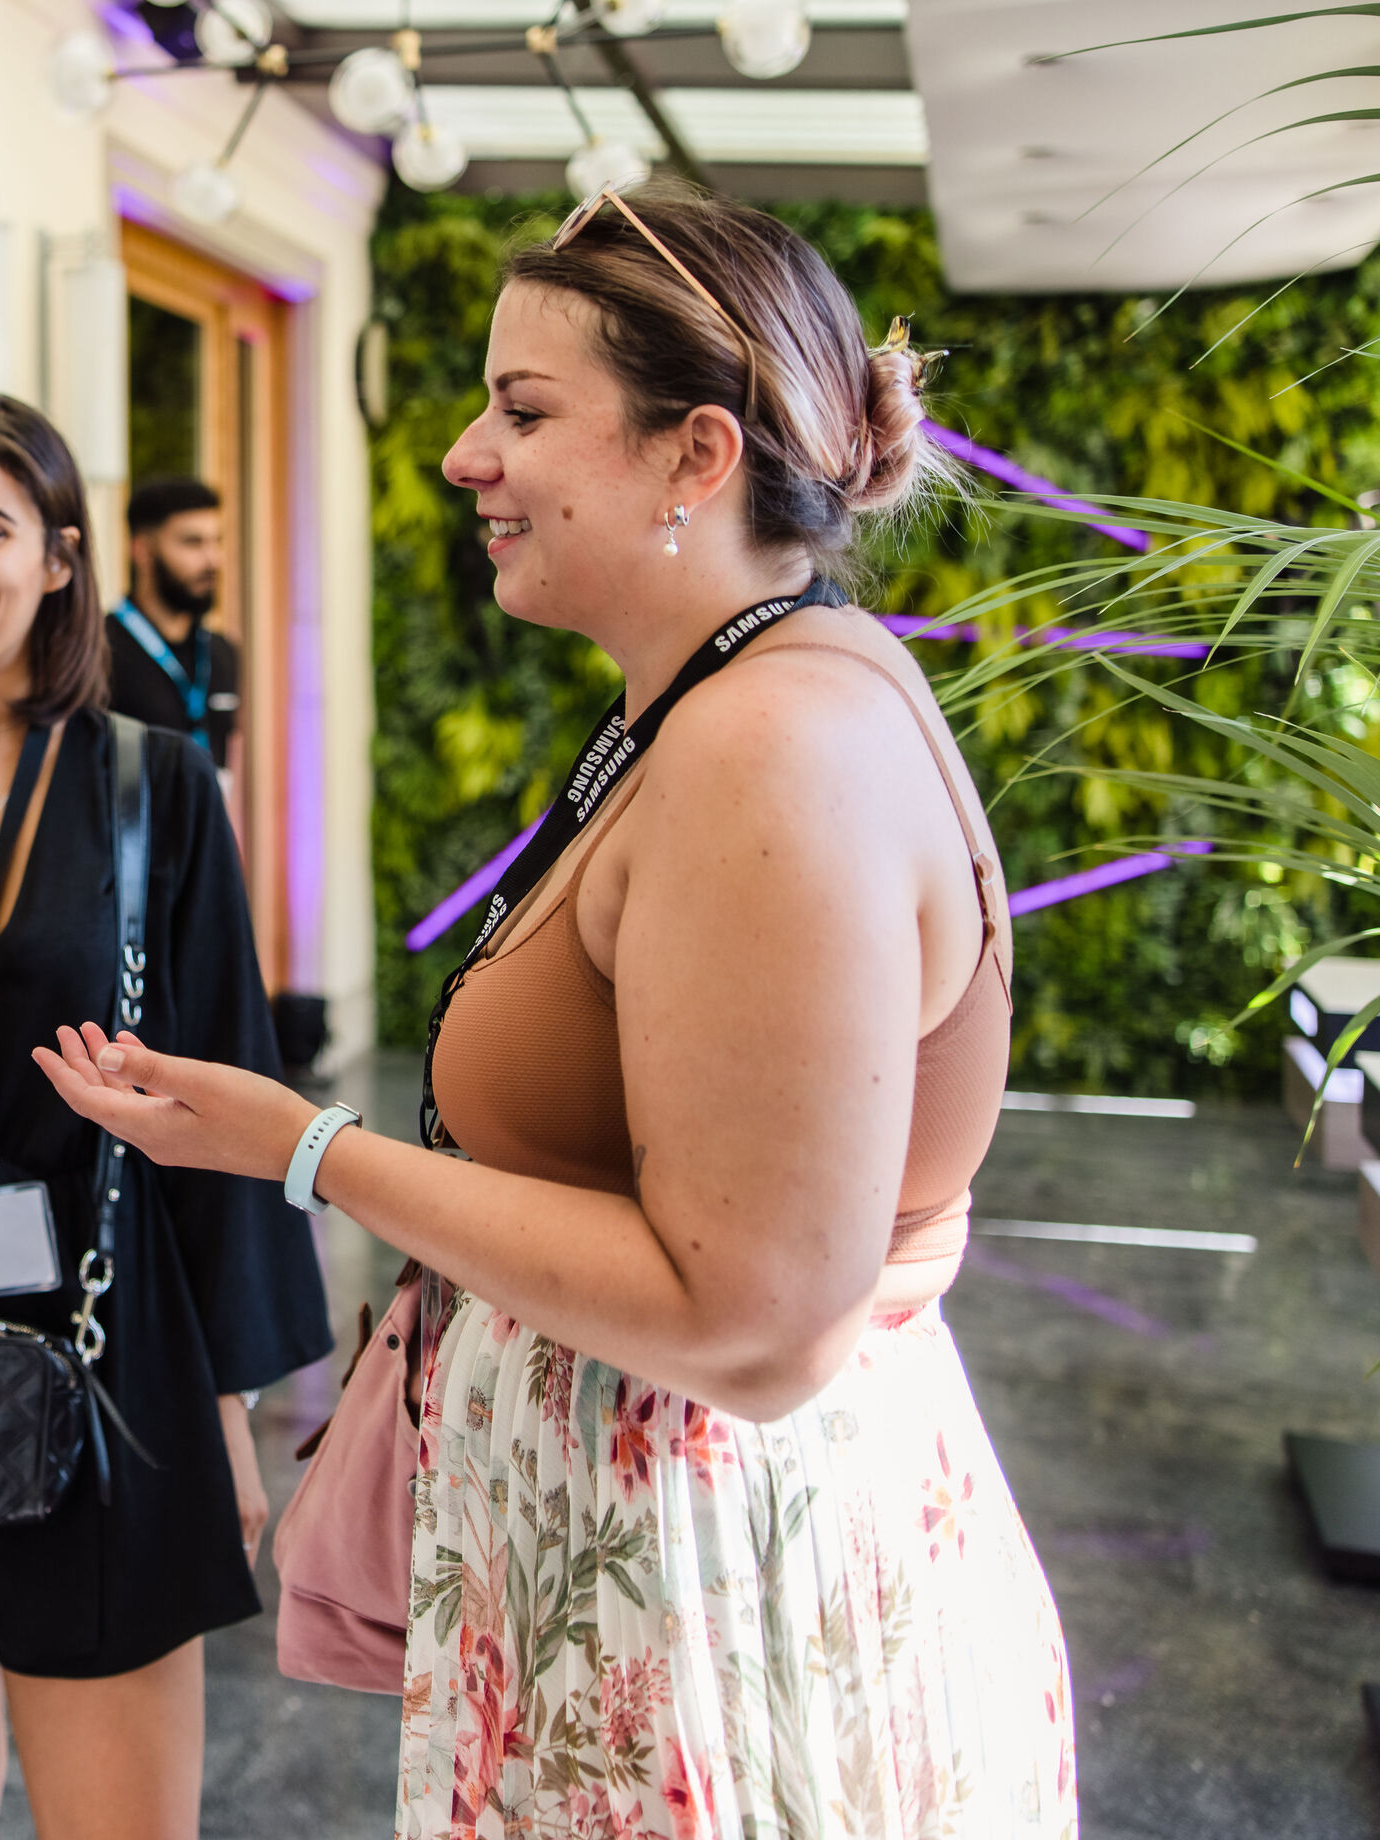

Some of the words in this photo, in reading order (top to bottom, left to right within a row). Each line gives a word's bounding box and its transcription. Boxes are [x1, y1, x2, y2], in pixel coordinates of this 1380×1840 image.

[715, 601, 795, 652] SAMSUN
[567, 715, 625, 803] SAMSUNG
[577, 736, 636, 823] SAMSUNG
